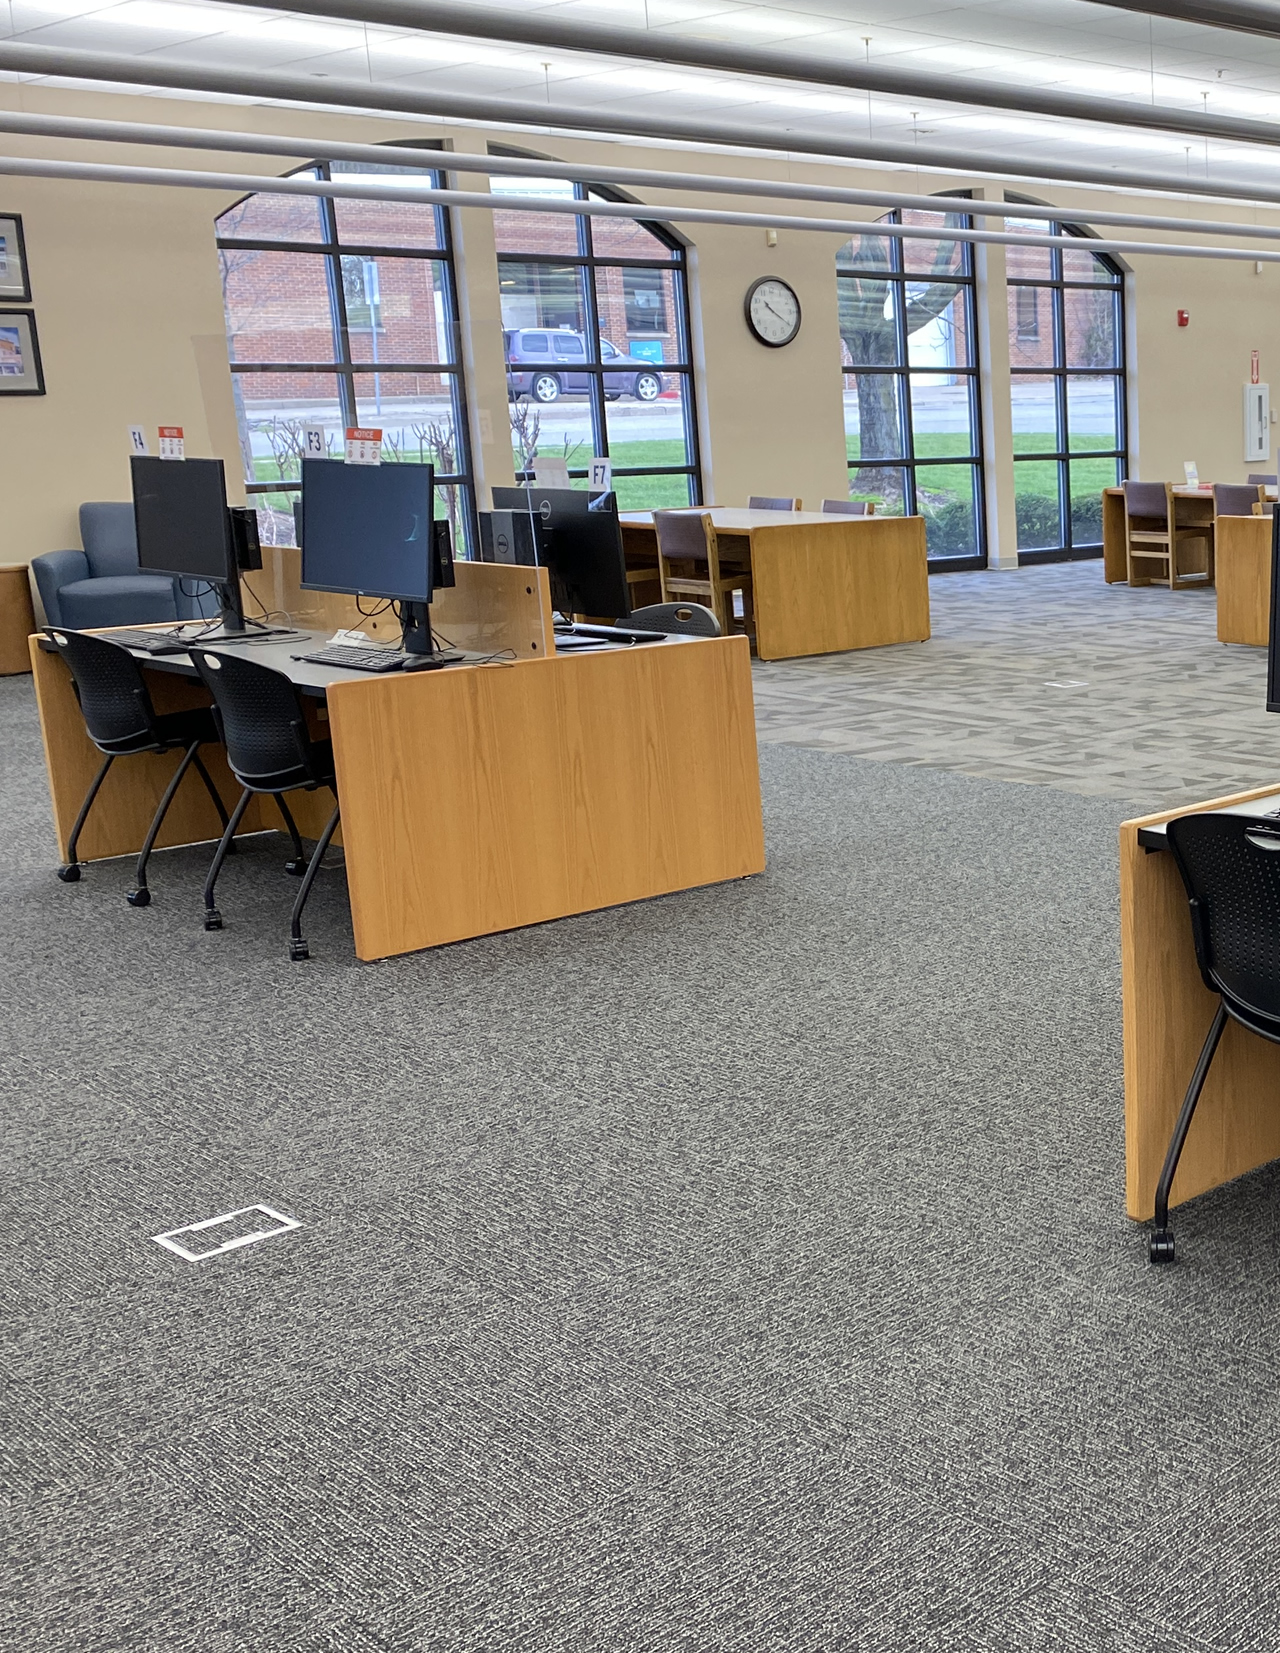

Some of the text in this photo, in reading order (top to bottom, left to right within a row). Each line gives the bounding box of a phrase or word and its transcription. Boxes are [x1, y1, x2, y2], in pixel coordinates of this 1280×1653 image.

[132, 431, 144, 449] F4
[307, 431, 321, 451] F3
[353, 430, 374, 439] NOTICE
[593, 465, 606, 484] F7
